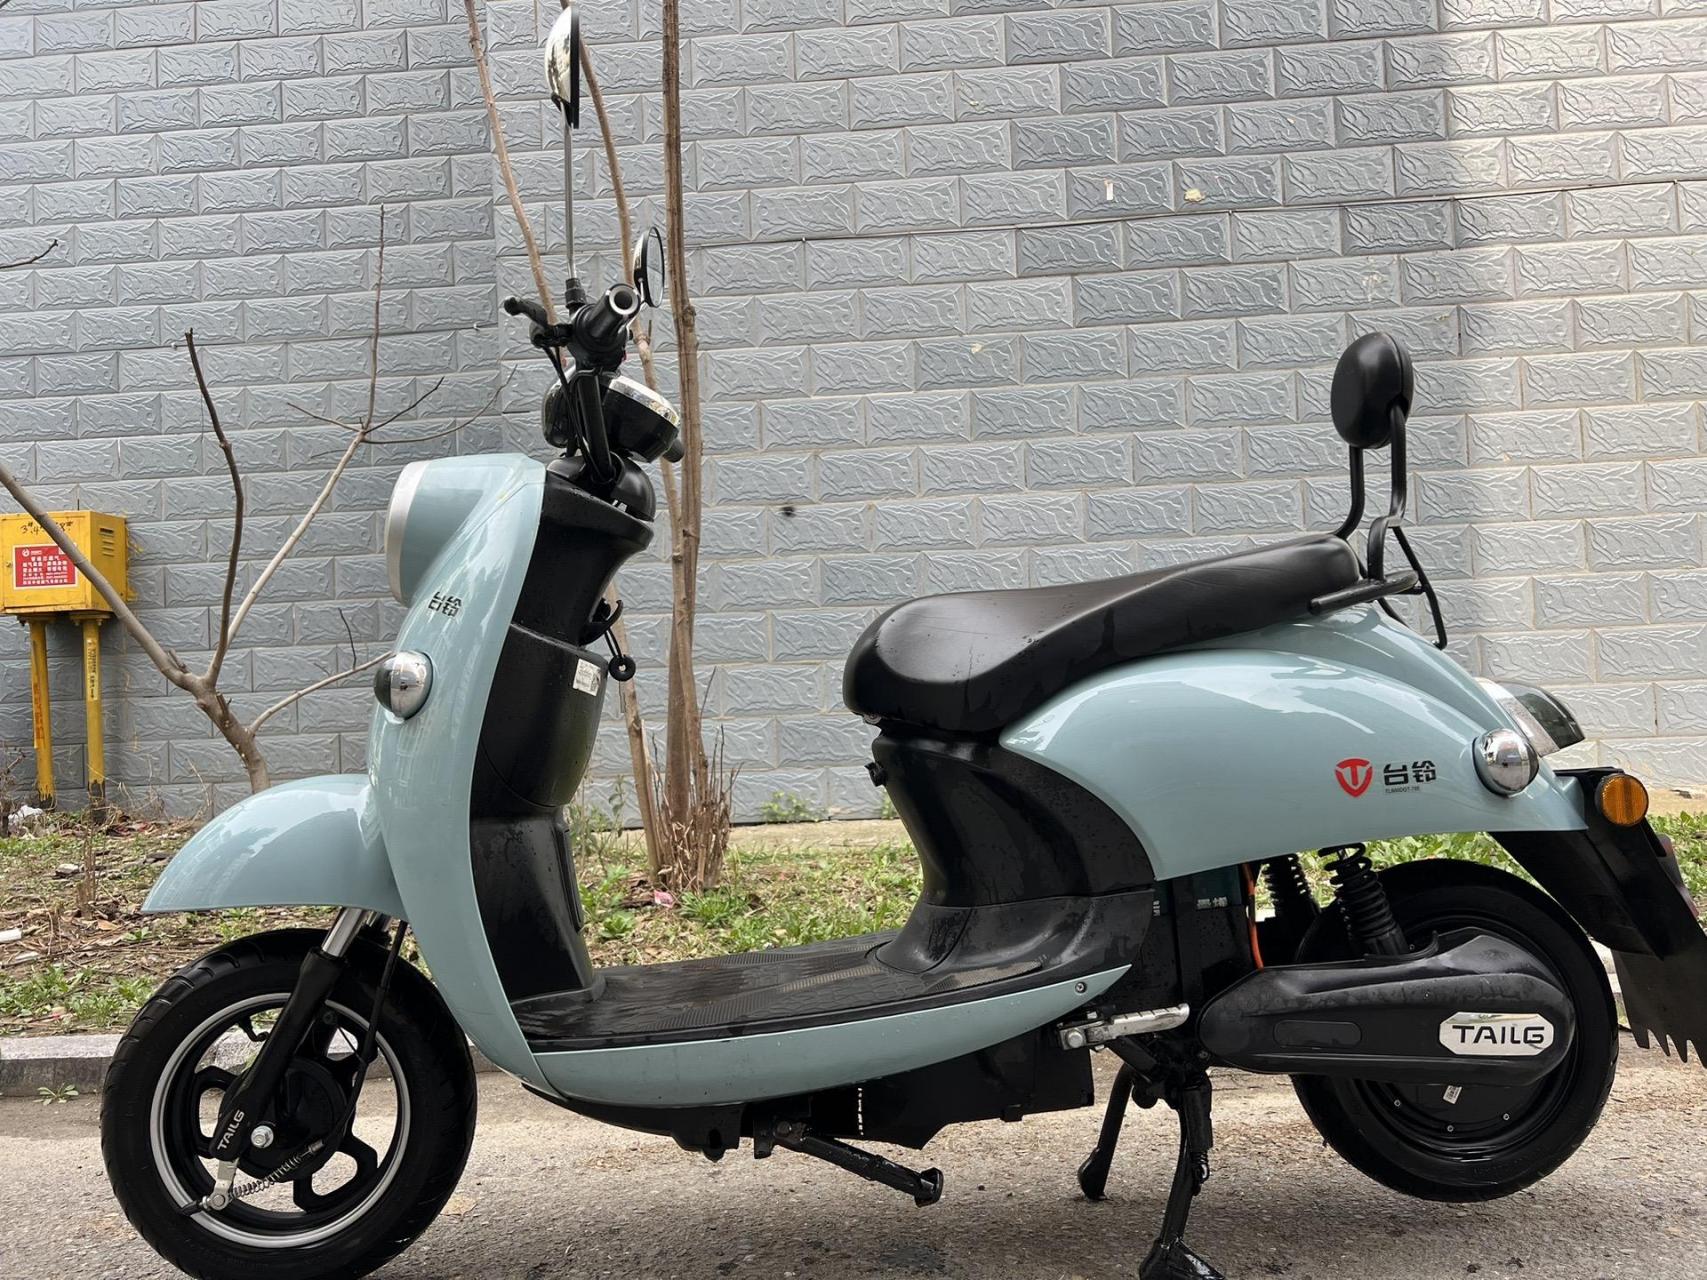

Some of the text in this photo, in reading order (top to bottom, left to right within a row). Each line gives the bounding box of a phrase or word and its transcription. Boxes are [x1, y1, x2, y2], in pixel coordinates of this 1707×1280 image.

[1383, 760, 1437, 785] 台铃
[1452, 1025, 1545, 1044] TAILG
[217, 1109, 245, 1150] TAILG
